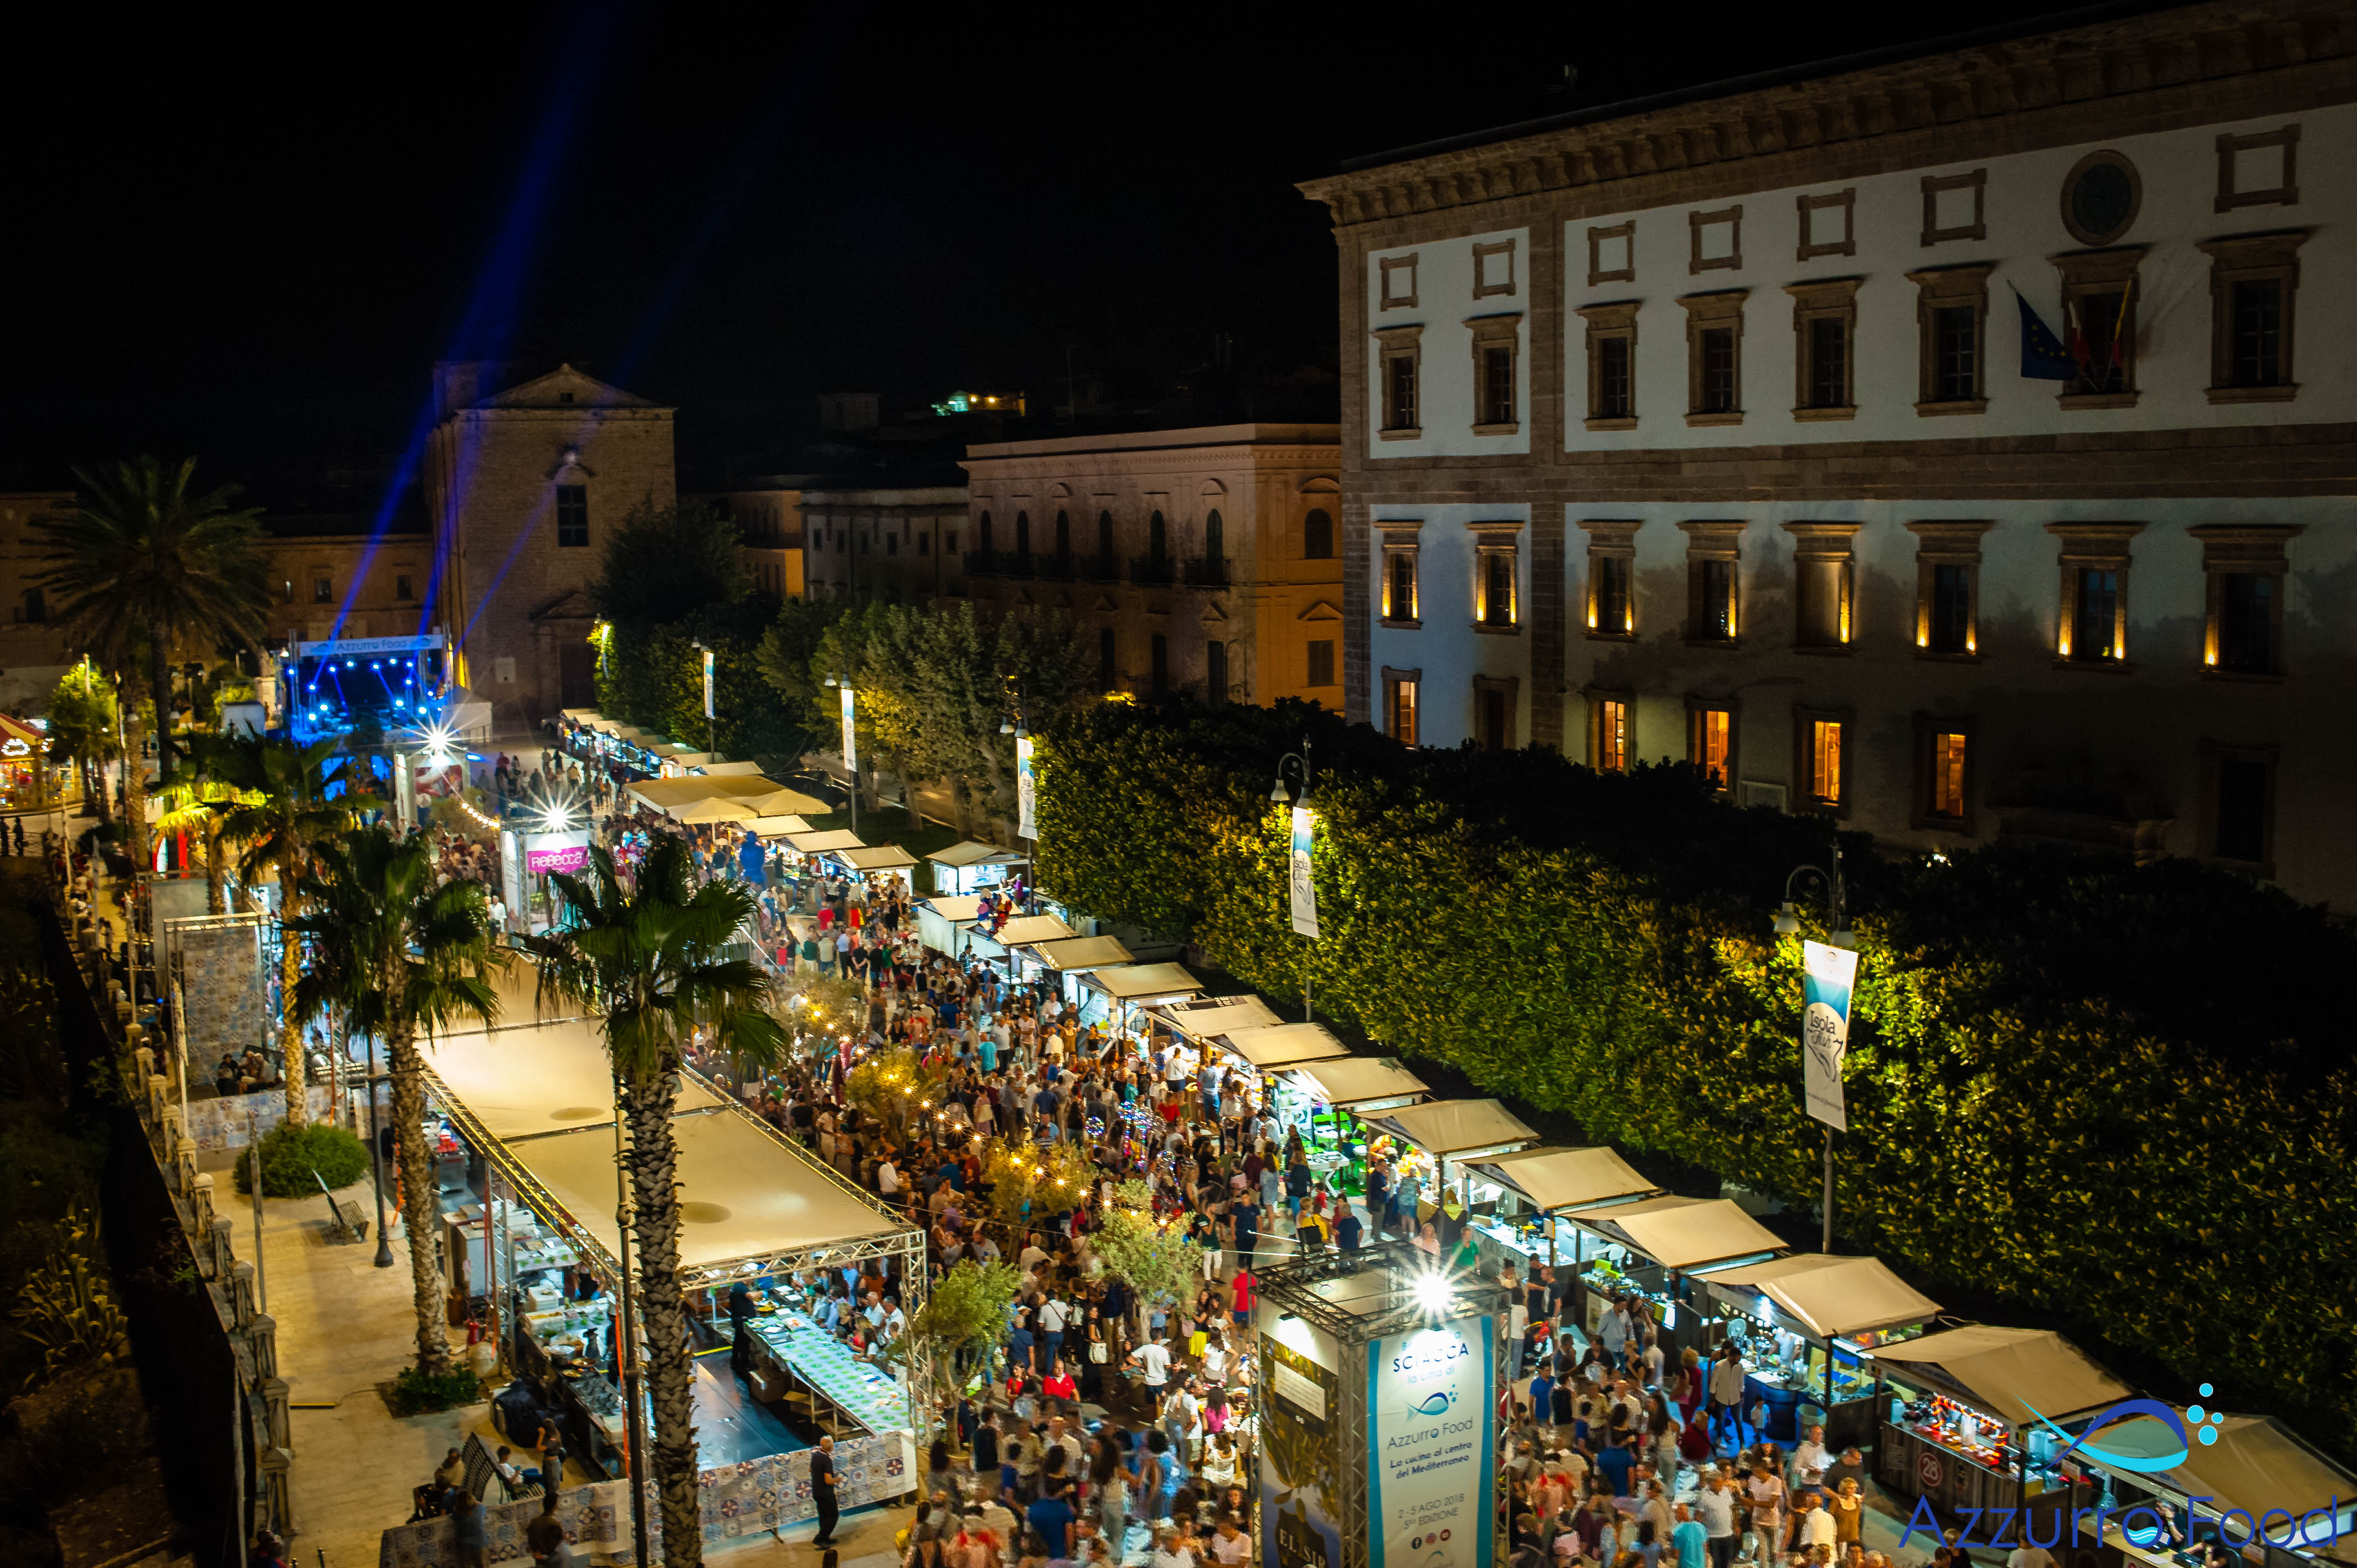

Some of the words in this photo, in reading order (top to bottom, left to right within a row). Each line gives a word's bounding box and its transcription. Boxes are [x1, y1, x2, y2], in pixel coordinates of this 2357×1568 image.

[336, 642, 379, 651] Azzurro
[382, 639, 408, 648] Food
[1810, 1010, 1835, 1035] Isola
[1387, 1428, 1439, 1451] Azzurro
[1442, 1416, 1474, 1435] Food
[1390, 1459, 1402, 1468] La
[1404, 1452, 1431, 1464] cucina
[1434, 1447, 1442, 1457] al
[1445, 1441, 1473, 1454] centro
[1396, 1468, 1409, 1479] del
[1412, 1454, 1469, 1475] Mediterraneo
[1922, 1457, 1939, 1480] 28
[1418, 1499, 1441, 1513] AGO
[1444, 1493, 1465, 1506] 2018
[1418, 1507, 1458, 1525] EDIZIONE
